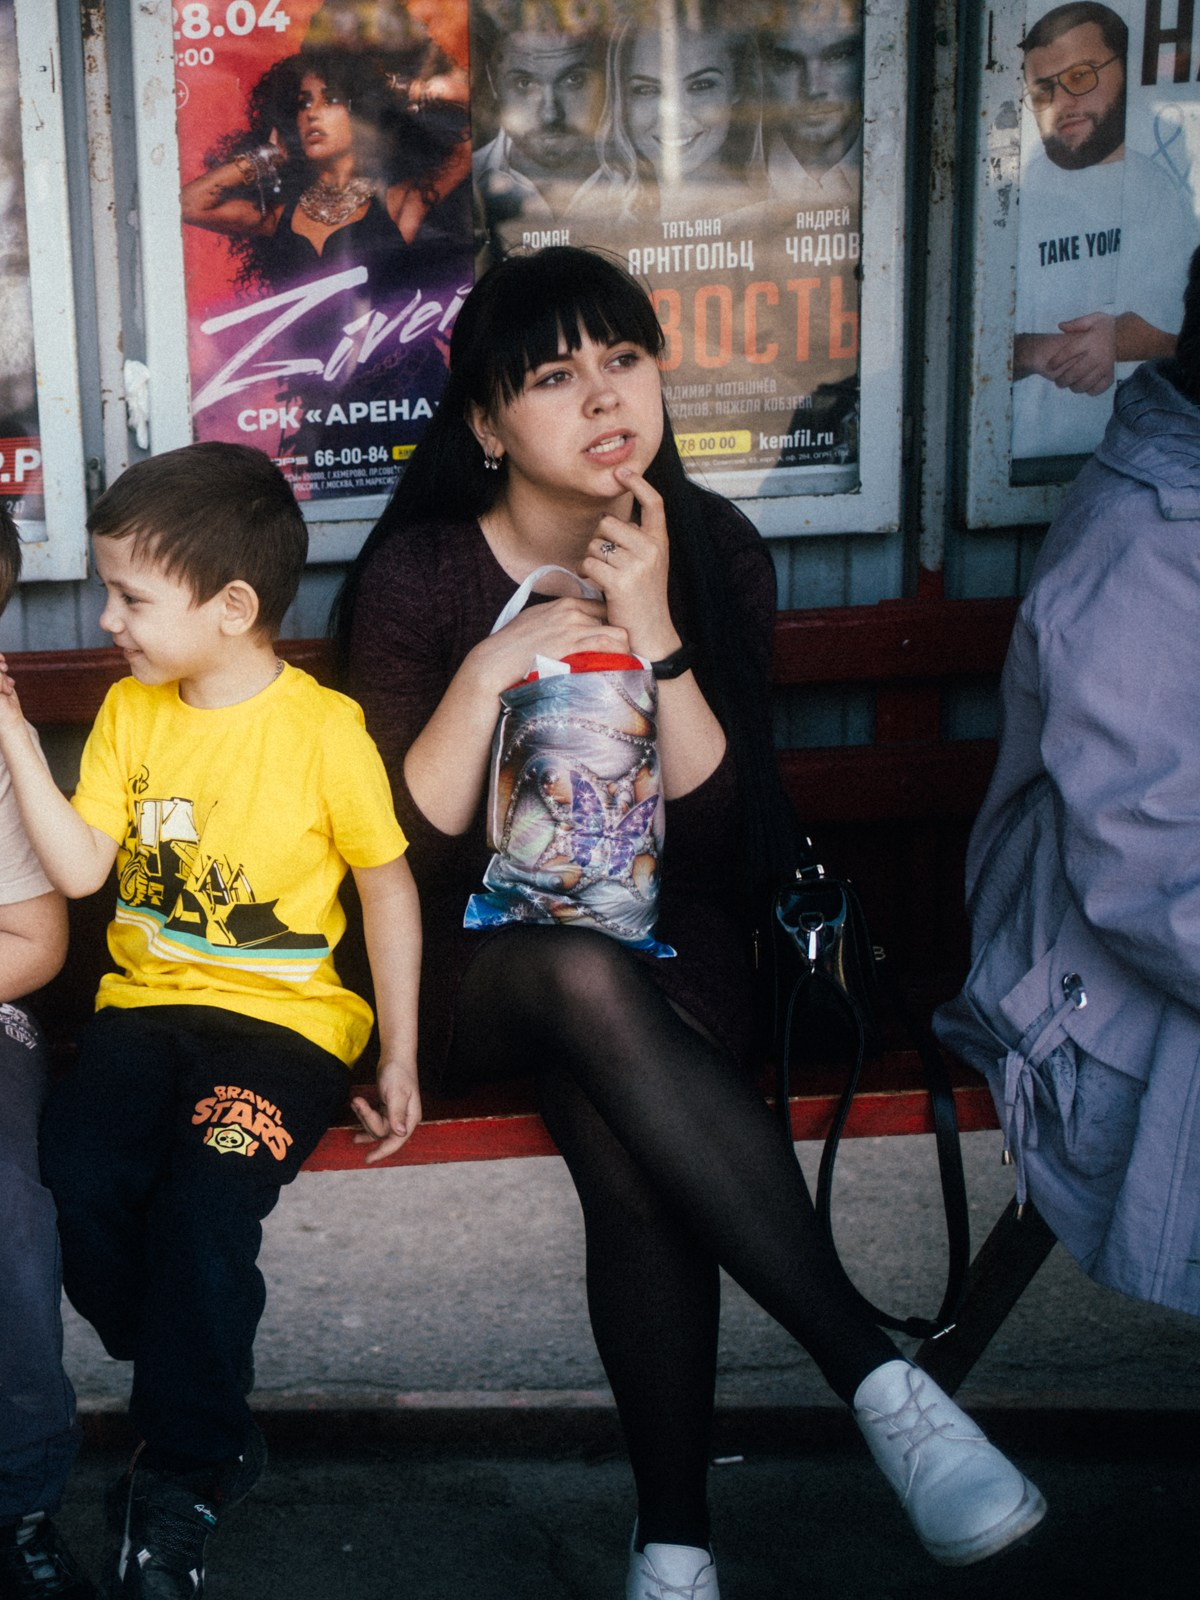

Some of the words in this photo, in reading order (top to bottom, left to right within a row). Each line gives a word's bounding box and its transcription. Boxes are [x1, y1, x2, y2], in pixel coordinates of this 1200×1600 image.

[175, 47, 214, 67] :00
[662, 219, 722, 239] ТАТЬЯНА
[796, 206, 850, 231] АНДРЕЙ
[522, 229, 570, 248] РОМАН
[785, 232, 860, 266] ЧАДОВ
[1038, 236, 1080, 267] TAKE
[628, 239, 755, 276] АРНТГОЛЬЦ
[237, 405, 300, 432] СРК
[305, 397, 440, 427] «АРЕНА
[759, 429, 834, 451] kemfil.ru
[314, 446, 389, 467] 66-00-84
[213, 1085, 284, 1126] BRAWL
[191, 1096, 294, 1161] STARS
